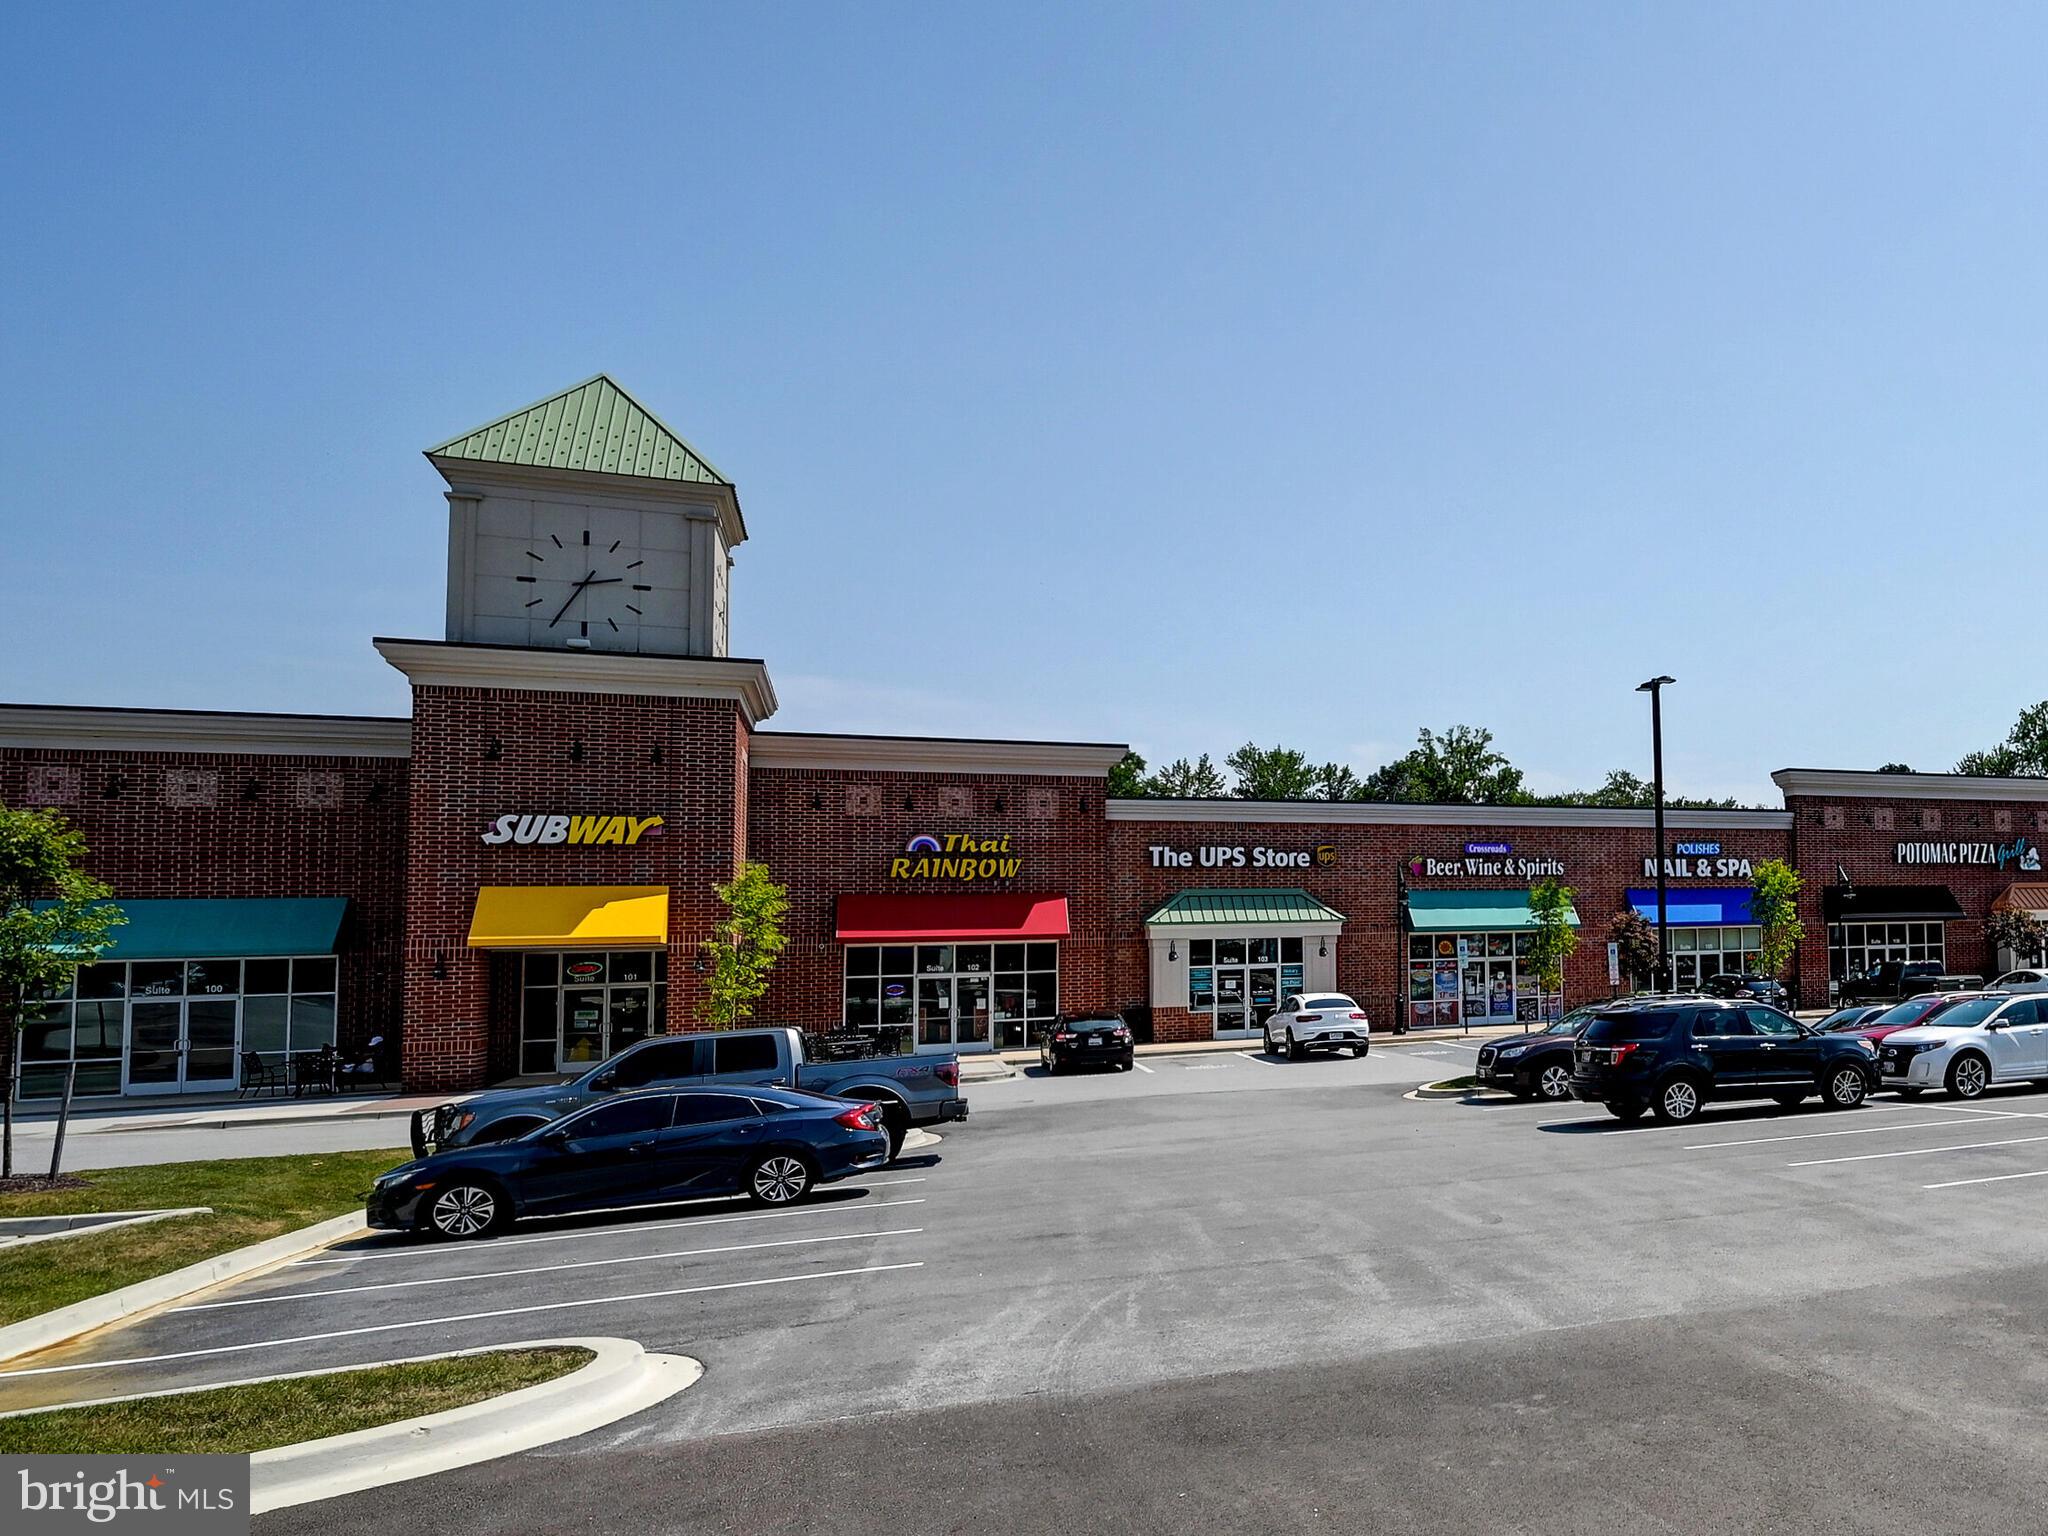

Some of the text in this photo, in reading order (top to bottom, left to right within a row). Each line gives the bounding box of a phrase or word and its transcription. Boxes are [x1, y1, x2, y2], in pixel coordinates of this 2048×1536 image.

[481, 814, 665, 846] SUBWAY
[944, 833, 1010, 854] Thai
[1468, 843, 1507, 854] Crossroads
[1676, 843, 1721, 855] POLISHES
[1897, 842, 1996, 864] POTOMAC PIZZA
[1149, 846, 1311, 868] The UPS Store
[1317, 851, 1336, 865] ups
[890, 858, 1023, 881] RAINBOW
[1426, 858, 1565, 880] Beer, Wine & Spirits
[1644, 858, 1753, 878] NAIL & SPA
[623, 973, 638, 982] 101
[926, 963, 980, 973] Suite 102
[145, 984, 223, 996] Suite 100
